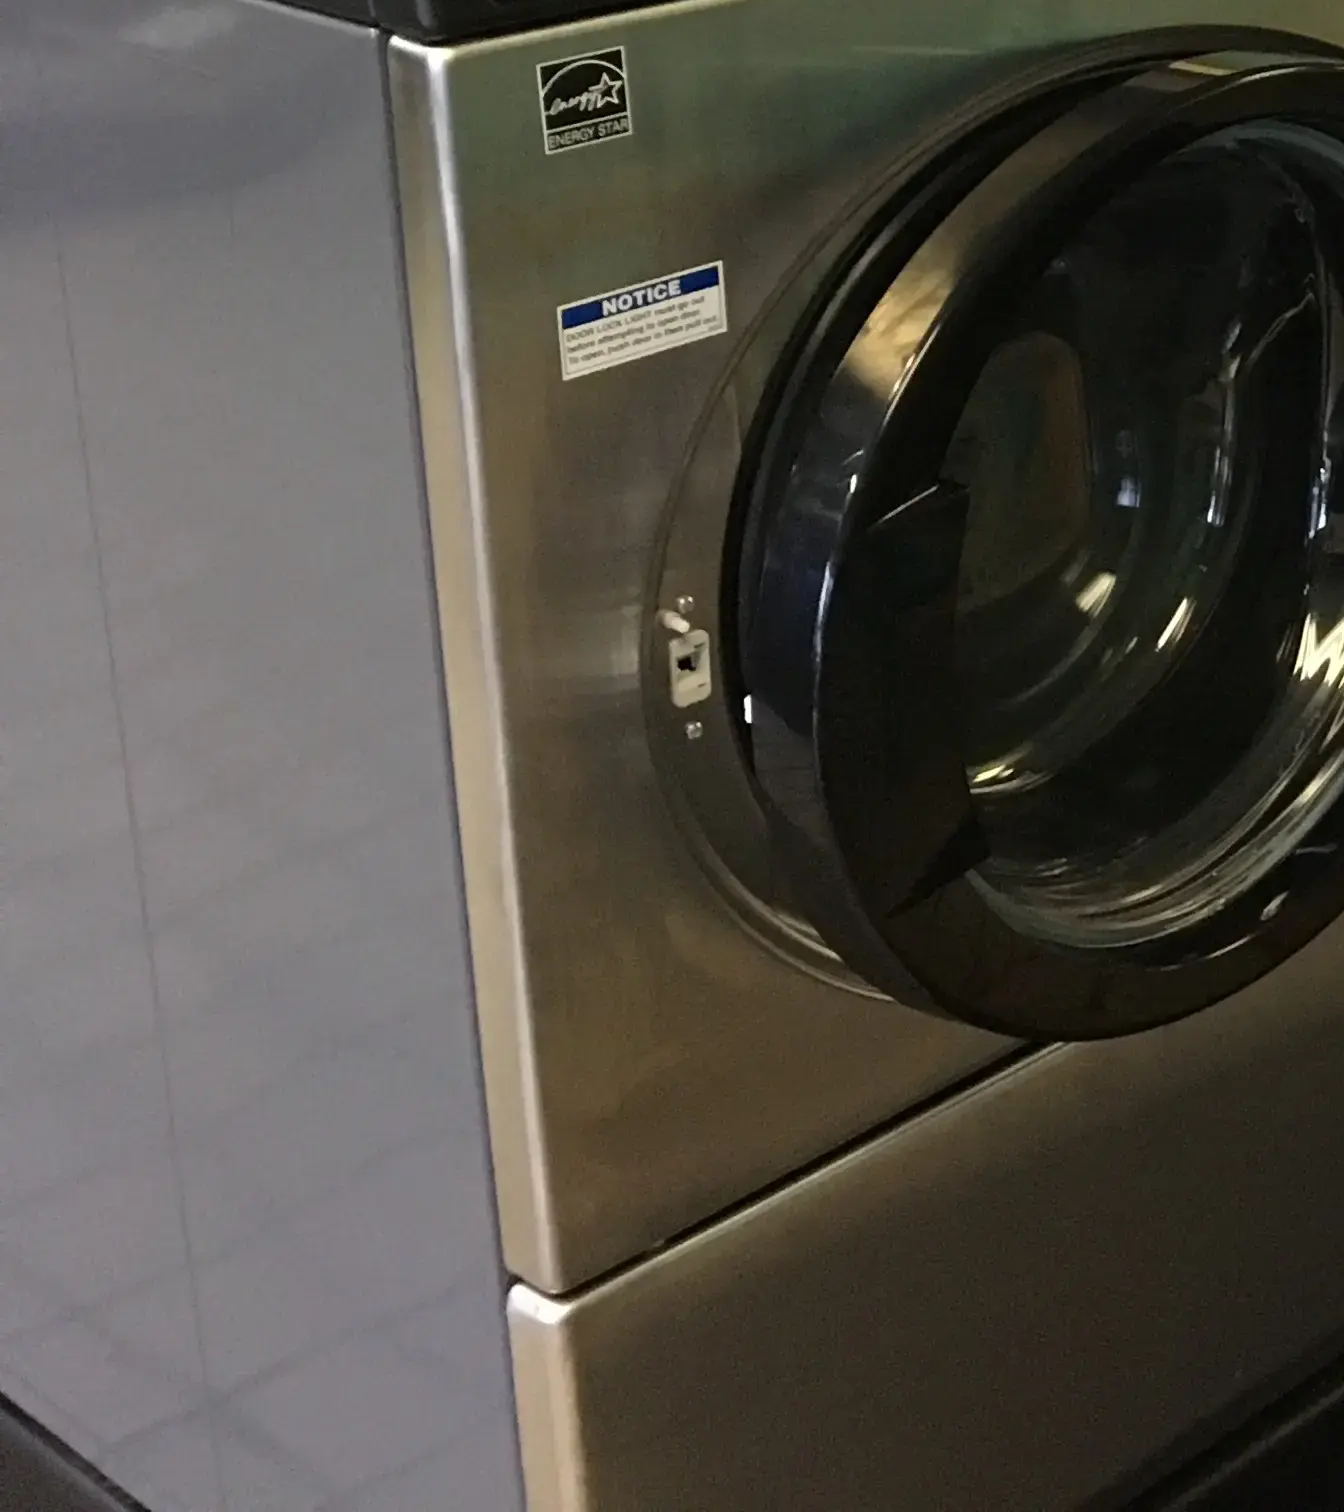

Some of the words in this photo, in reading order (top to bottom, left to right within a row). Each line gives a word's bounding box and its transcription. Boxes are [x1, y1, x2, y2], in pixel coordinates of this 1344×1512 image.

[548, 126, 595, 149] ENERGY
[597, 118, 629, 137] STAR
[602, 279, 682, 316] NOTICE
